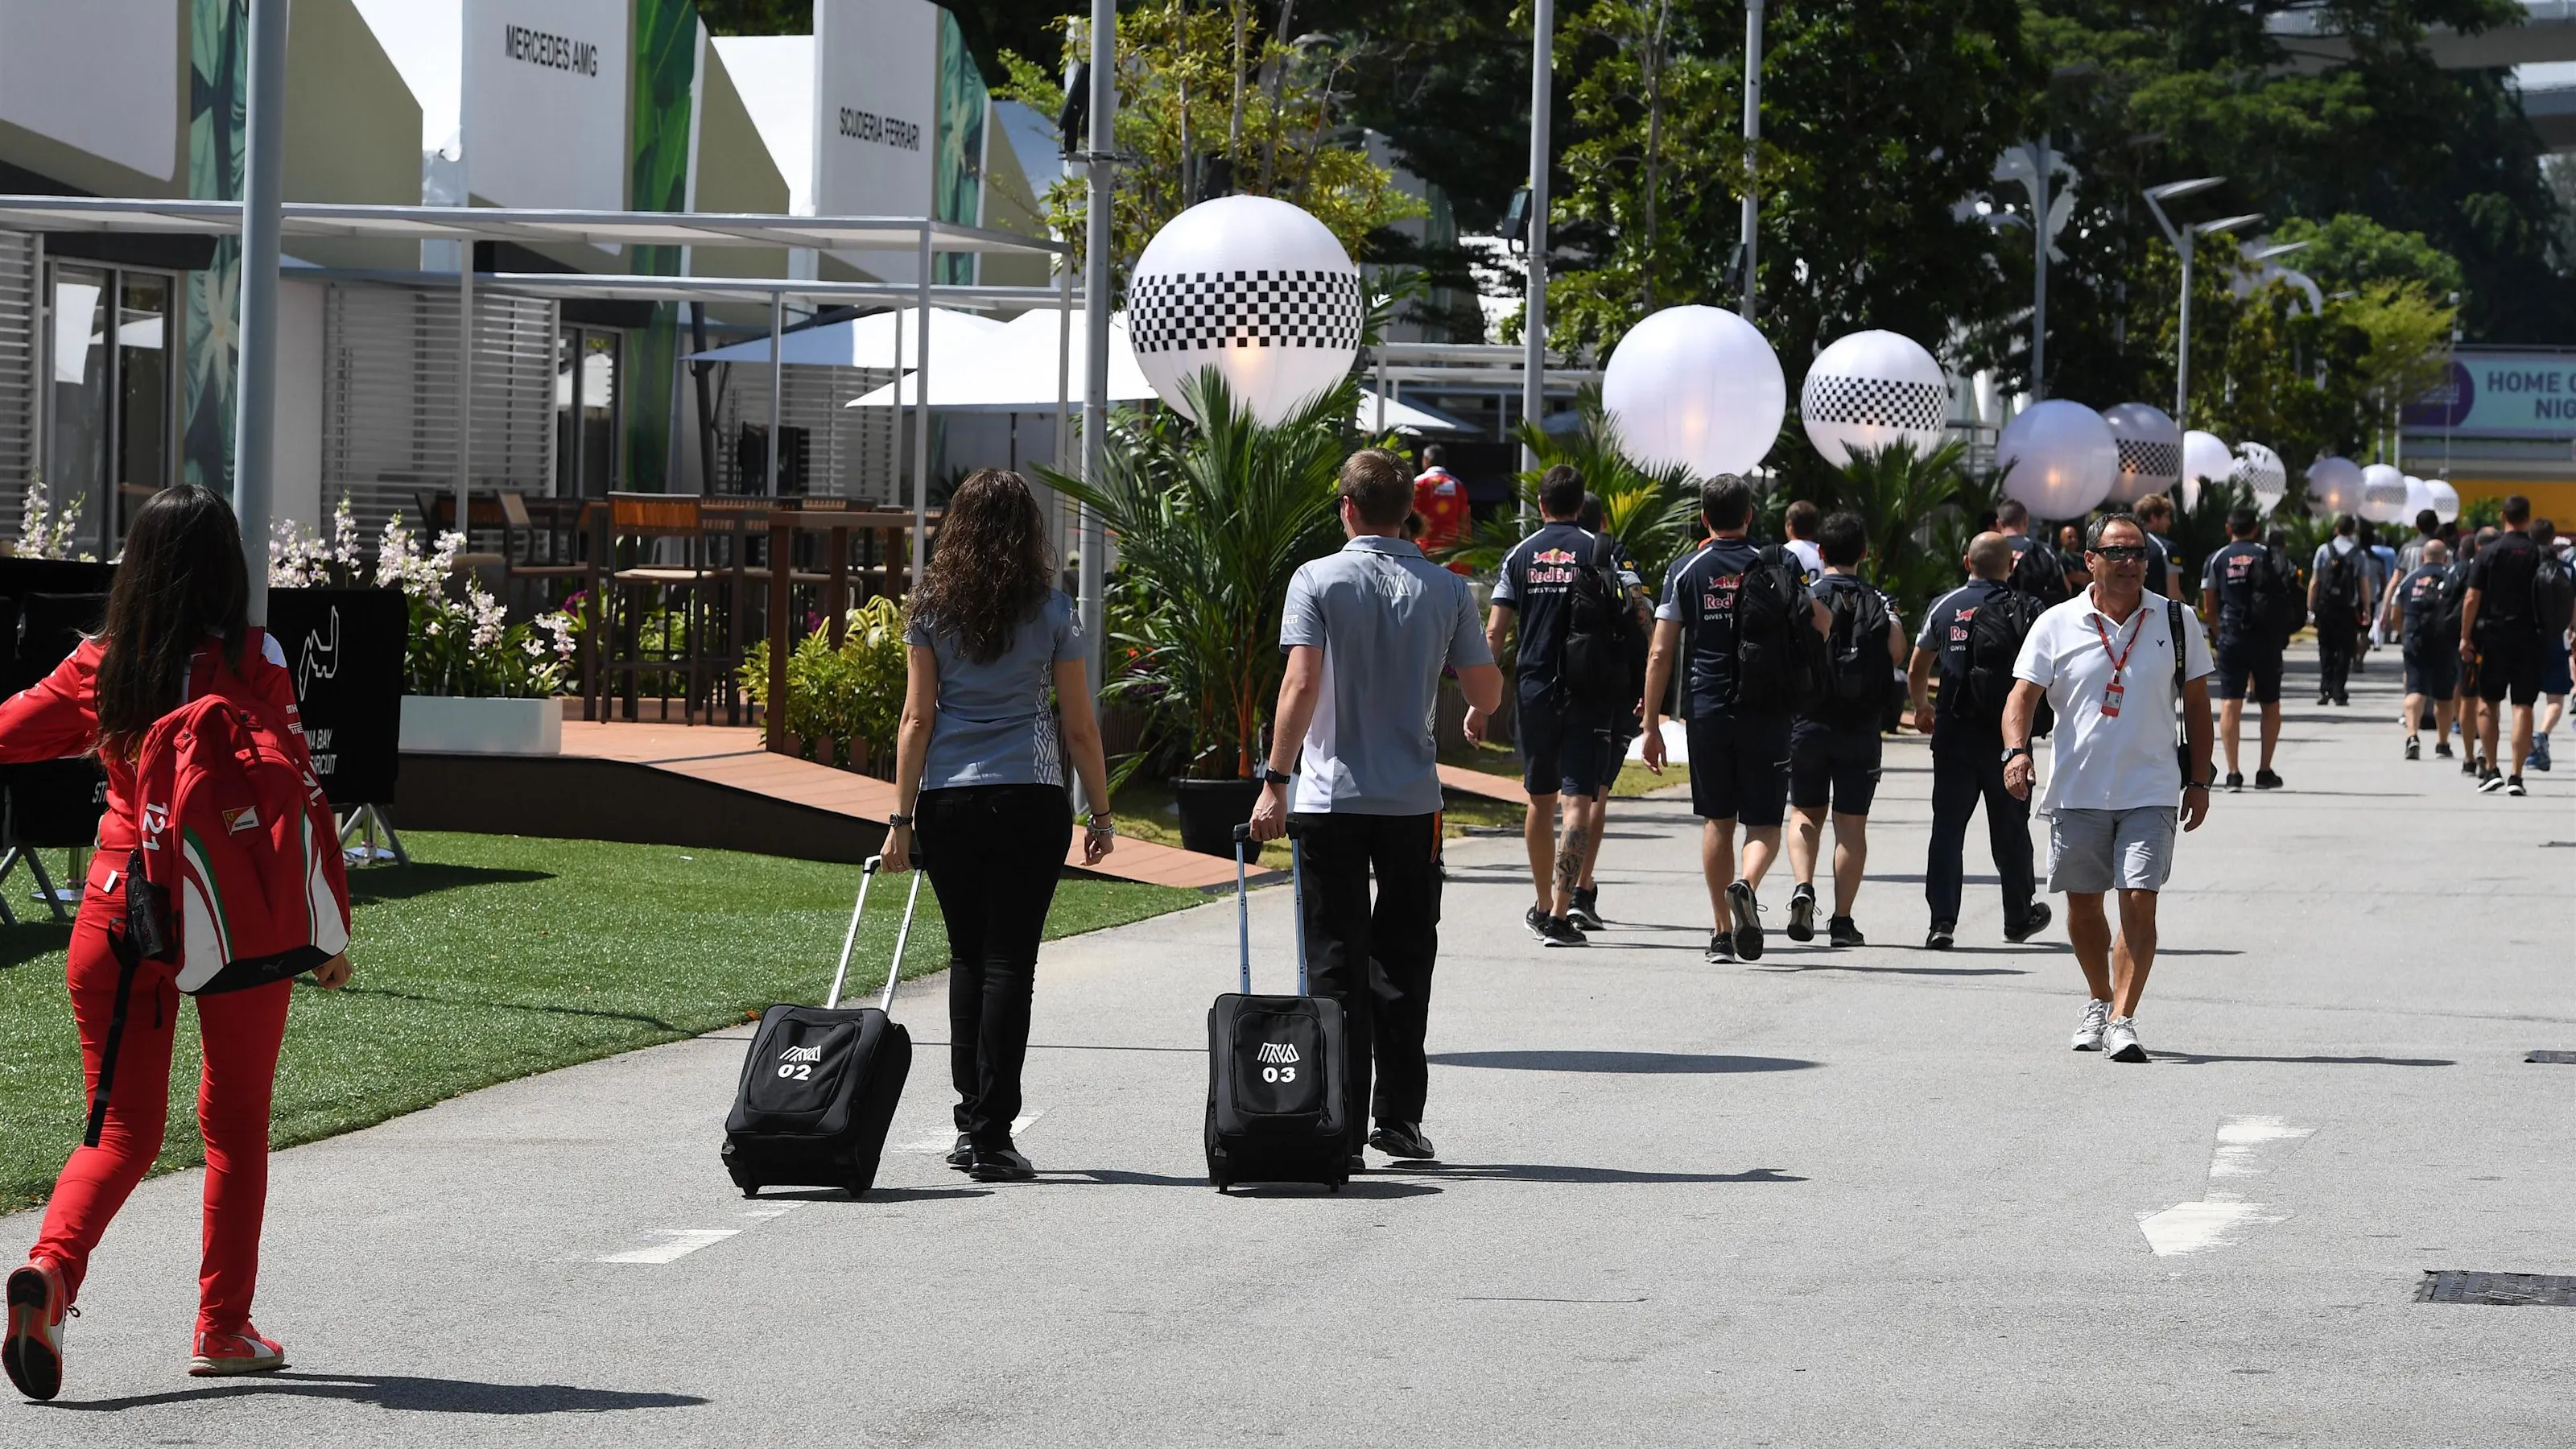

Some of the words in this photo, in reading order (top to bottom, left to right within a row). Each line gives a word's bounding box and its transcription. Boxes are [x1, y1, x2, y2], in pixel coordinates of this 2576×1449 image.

[506, 24, 570, 70] MERCEDES
[572, 41, 598, 77] AMG
[840, 106, 884, 143] SCUDERIA
[886, 117, 920, 151] FERRARI
[2487, 371, 2561, 393] HOME
[1526, 567, 1554, 584] Red
[1703, 592, 1733, 610] Red
[316, 729, 332, 749] BAY
[142, 802, 170, 850] 121
[778, 1063, 811, 1081] 02
[1262, 1067, 1296, 1083] 03
